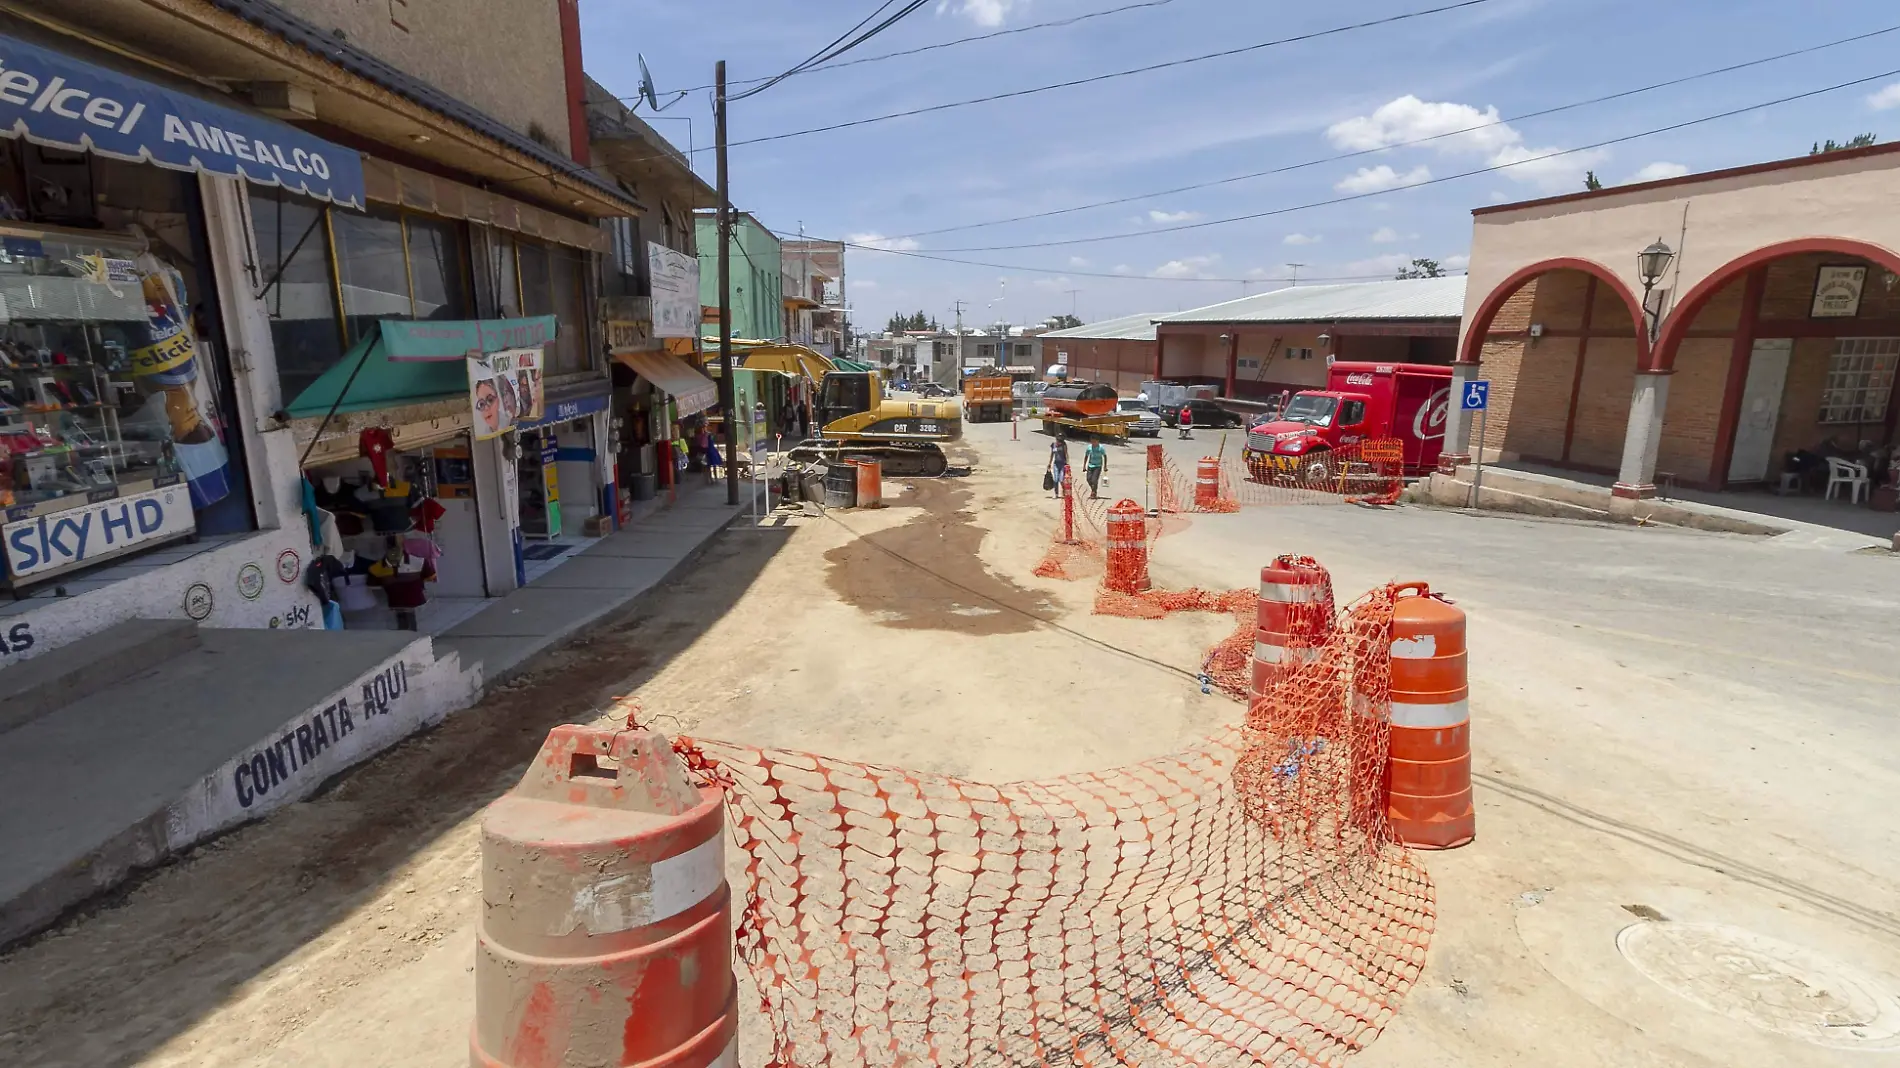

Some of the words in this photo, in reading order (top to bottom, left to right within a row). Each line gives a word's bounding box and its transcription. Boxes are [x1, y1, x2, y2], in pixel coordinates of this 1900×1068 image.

[163, 113, 331, 180] AMEALCO
[893, 423, 908, 433] CAT
[919, 424, 937, 433] 320C
[101, 498, 164, 545] HD
[234, 697, 355, 808] CONTRATA
[363, 660, 408, 720] AQUI
